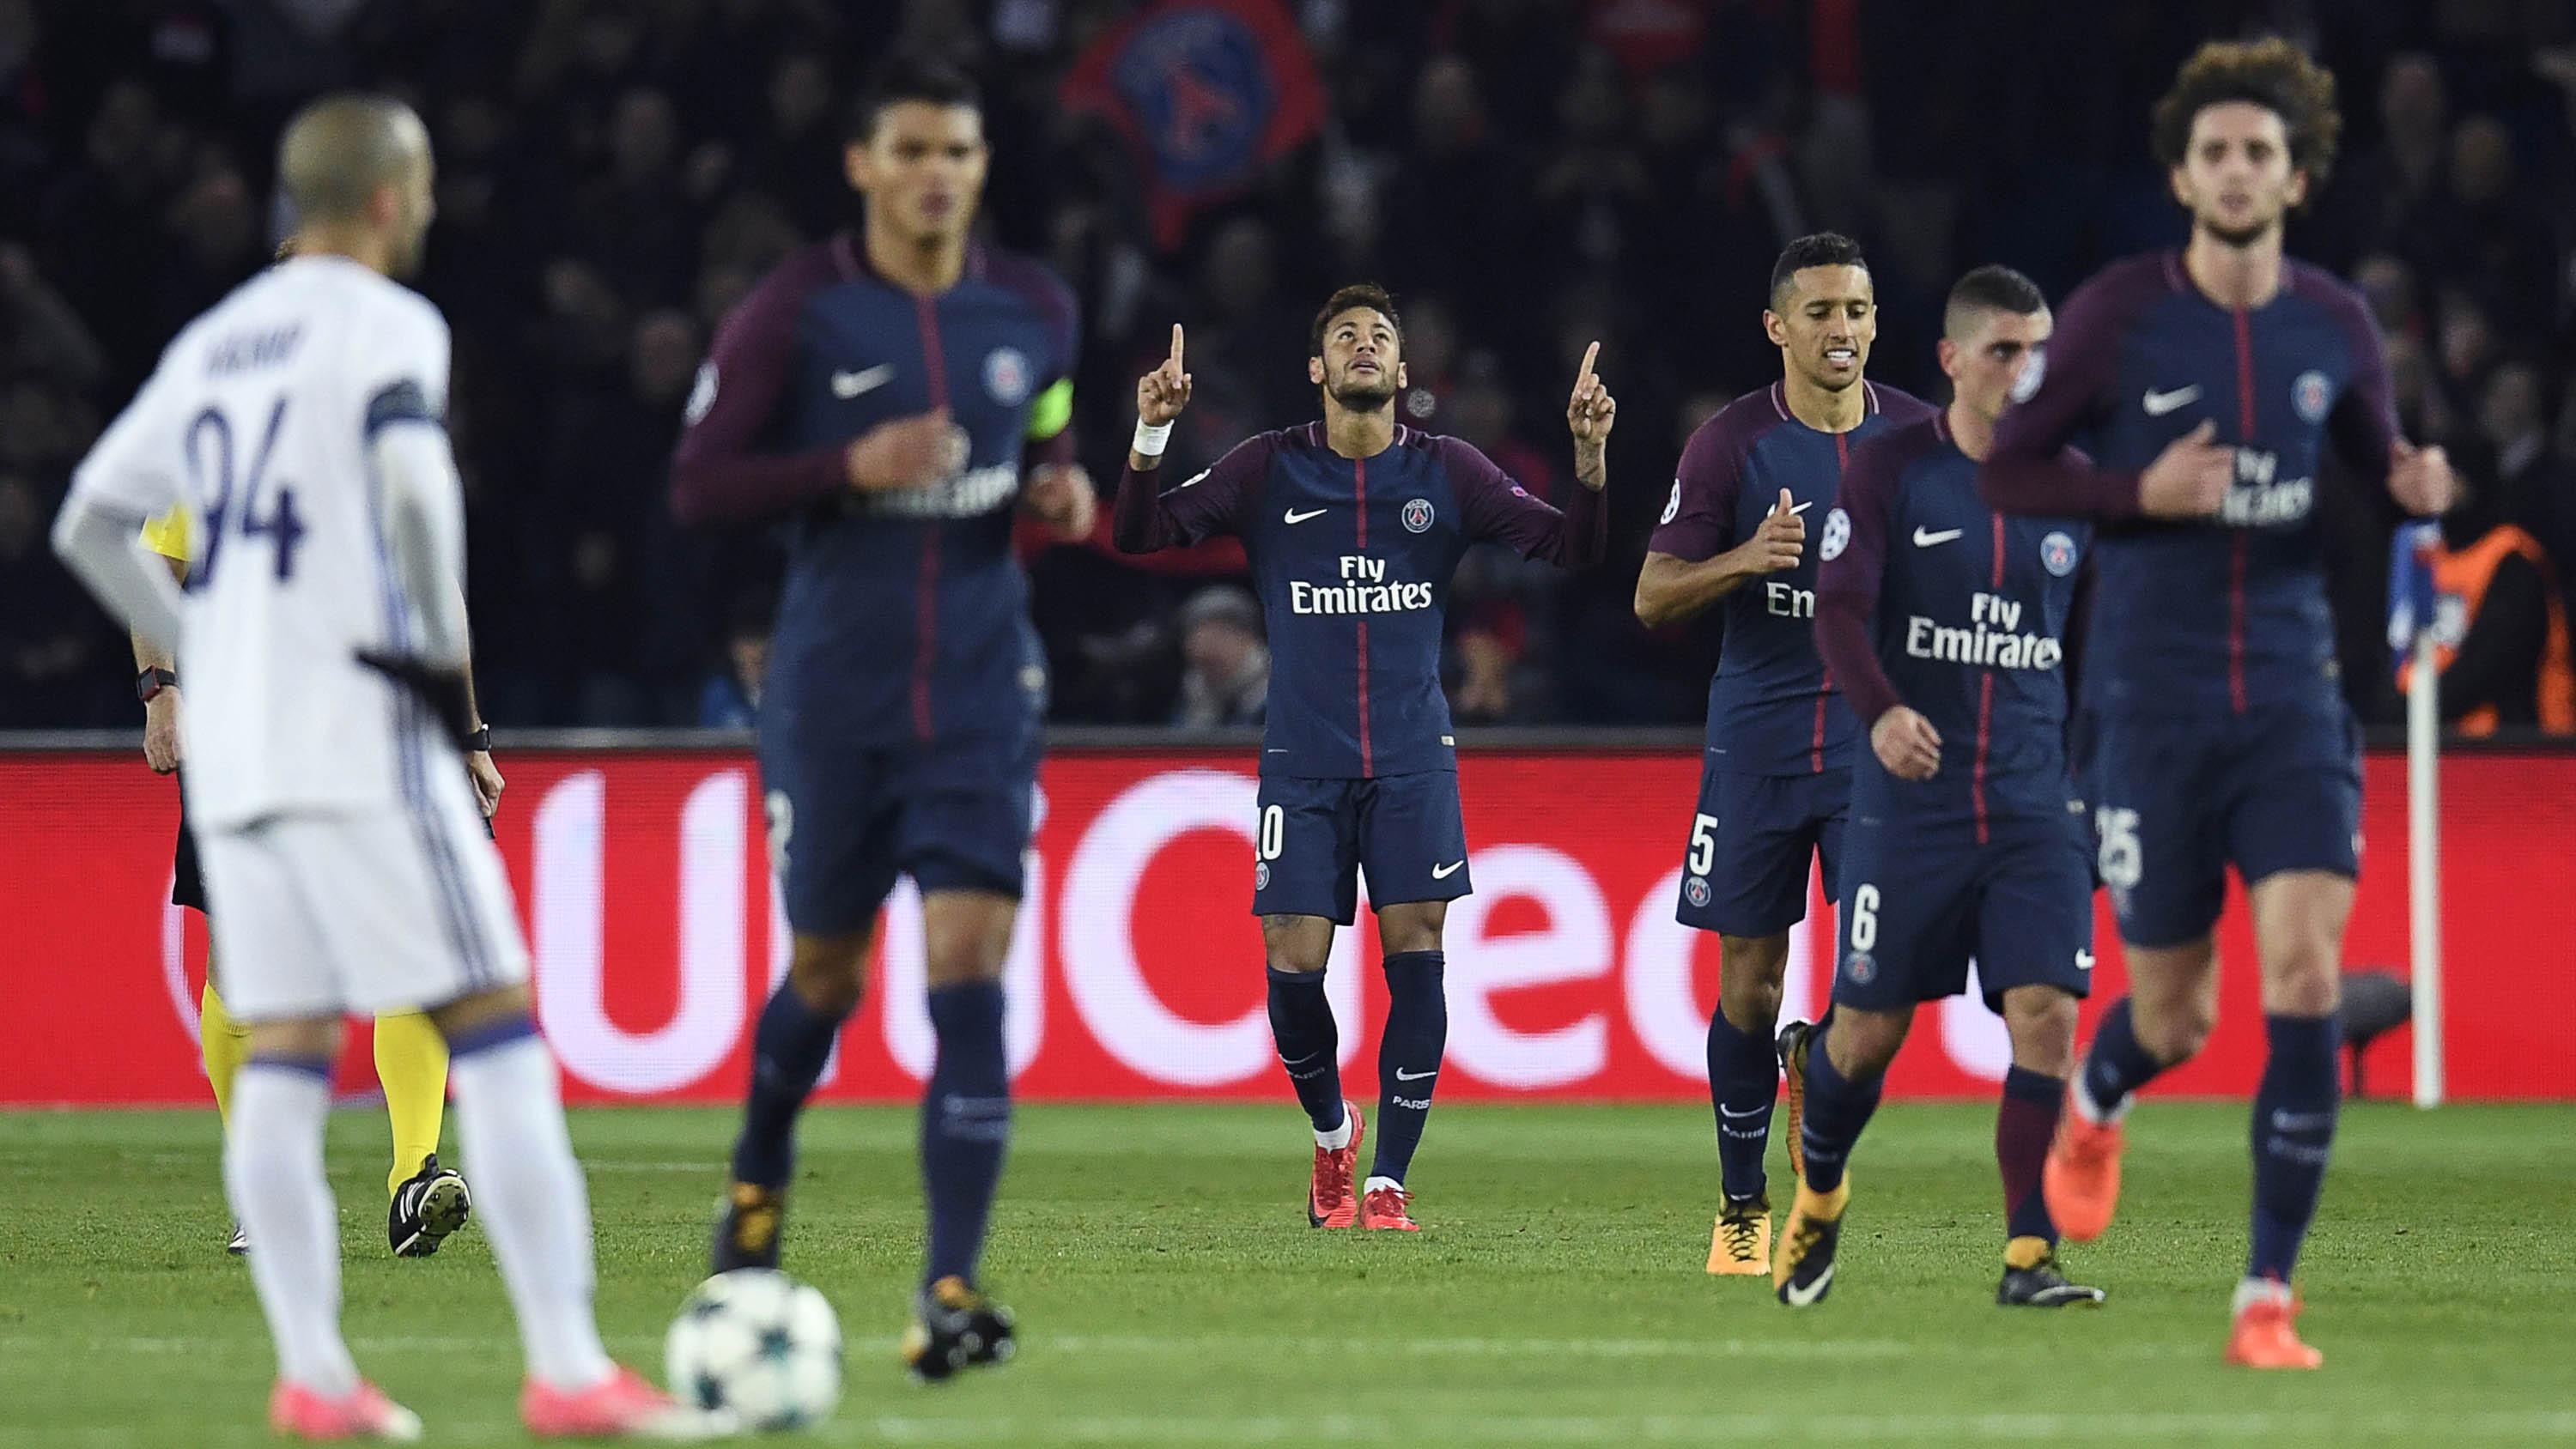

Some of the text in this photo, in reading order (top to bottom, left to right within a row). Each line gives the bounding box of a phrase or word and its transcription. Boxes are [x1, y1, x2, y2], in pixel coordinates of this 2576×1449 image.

[1340, 555, 1386, 583] Fly
[1290, 579, 1432, 614] Emirates
[1971, 591, 2022, 632] Fly
[1906, 615, 2063, 670] Emirate
[1689, 812, 1718, 876] 5
[1850, 883, 1880, 951] 6
